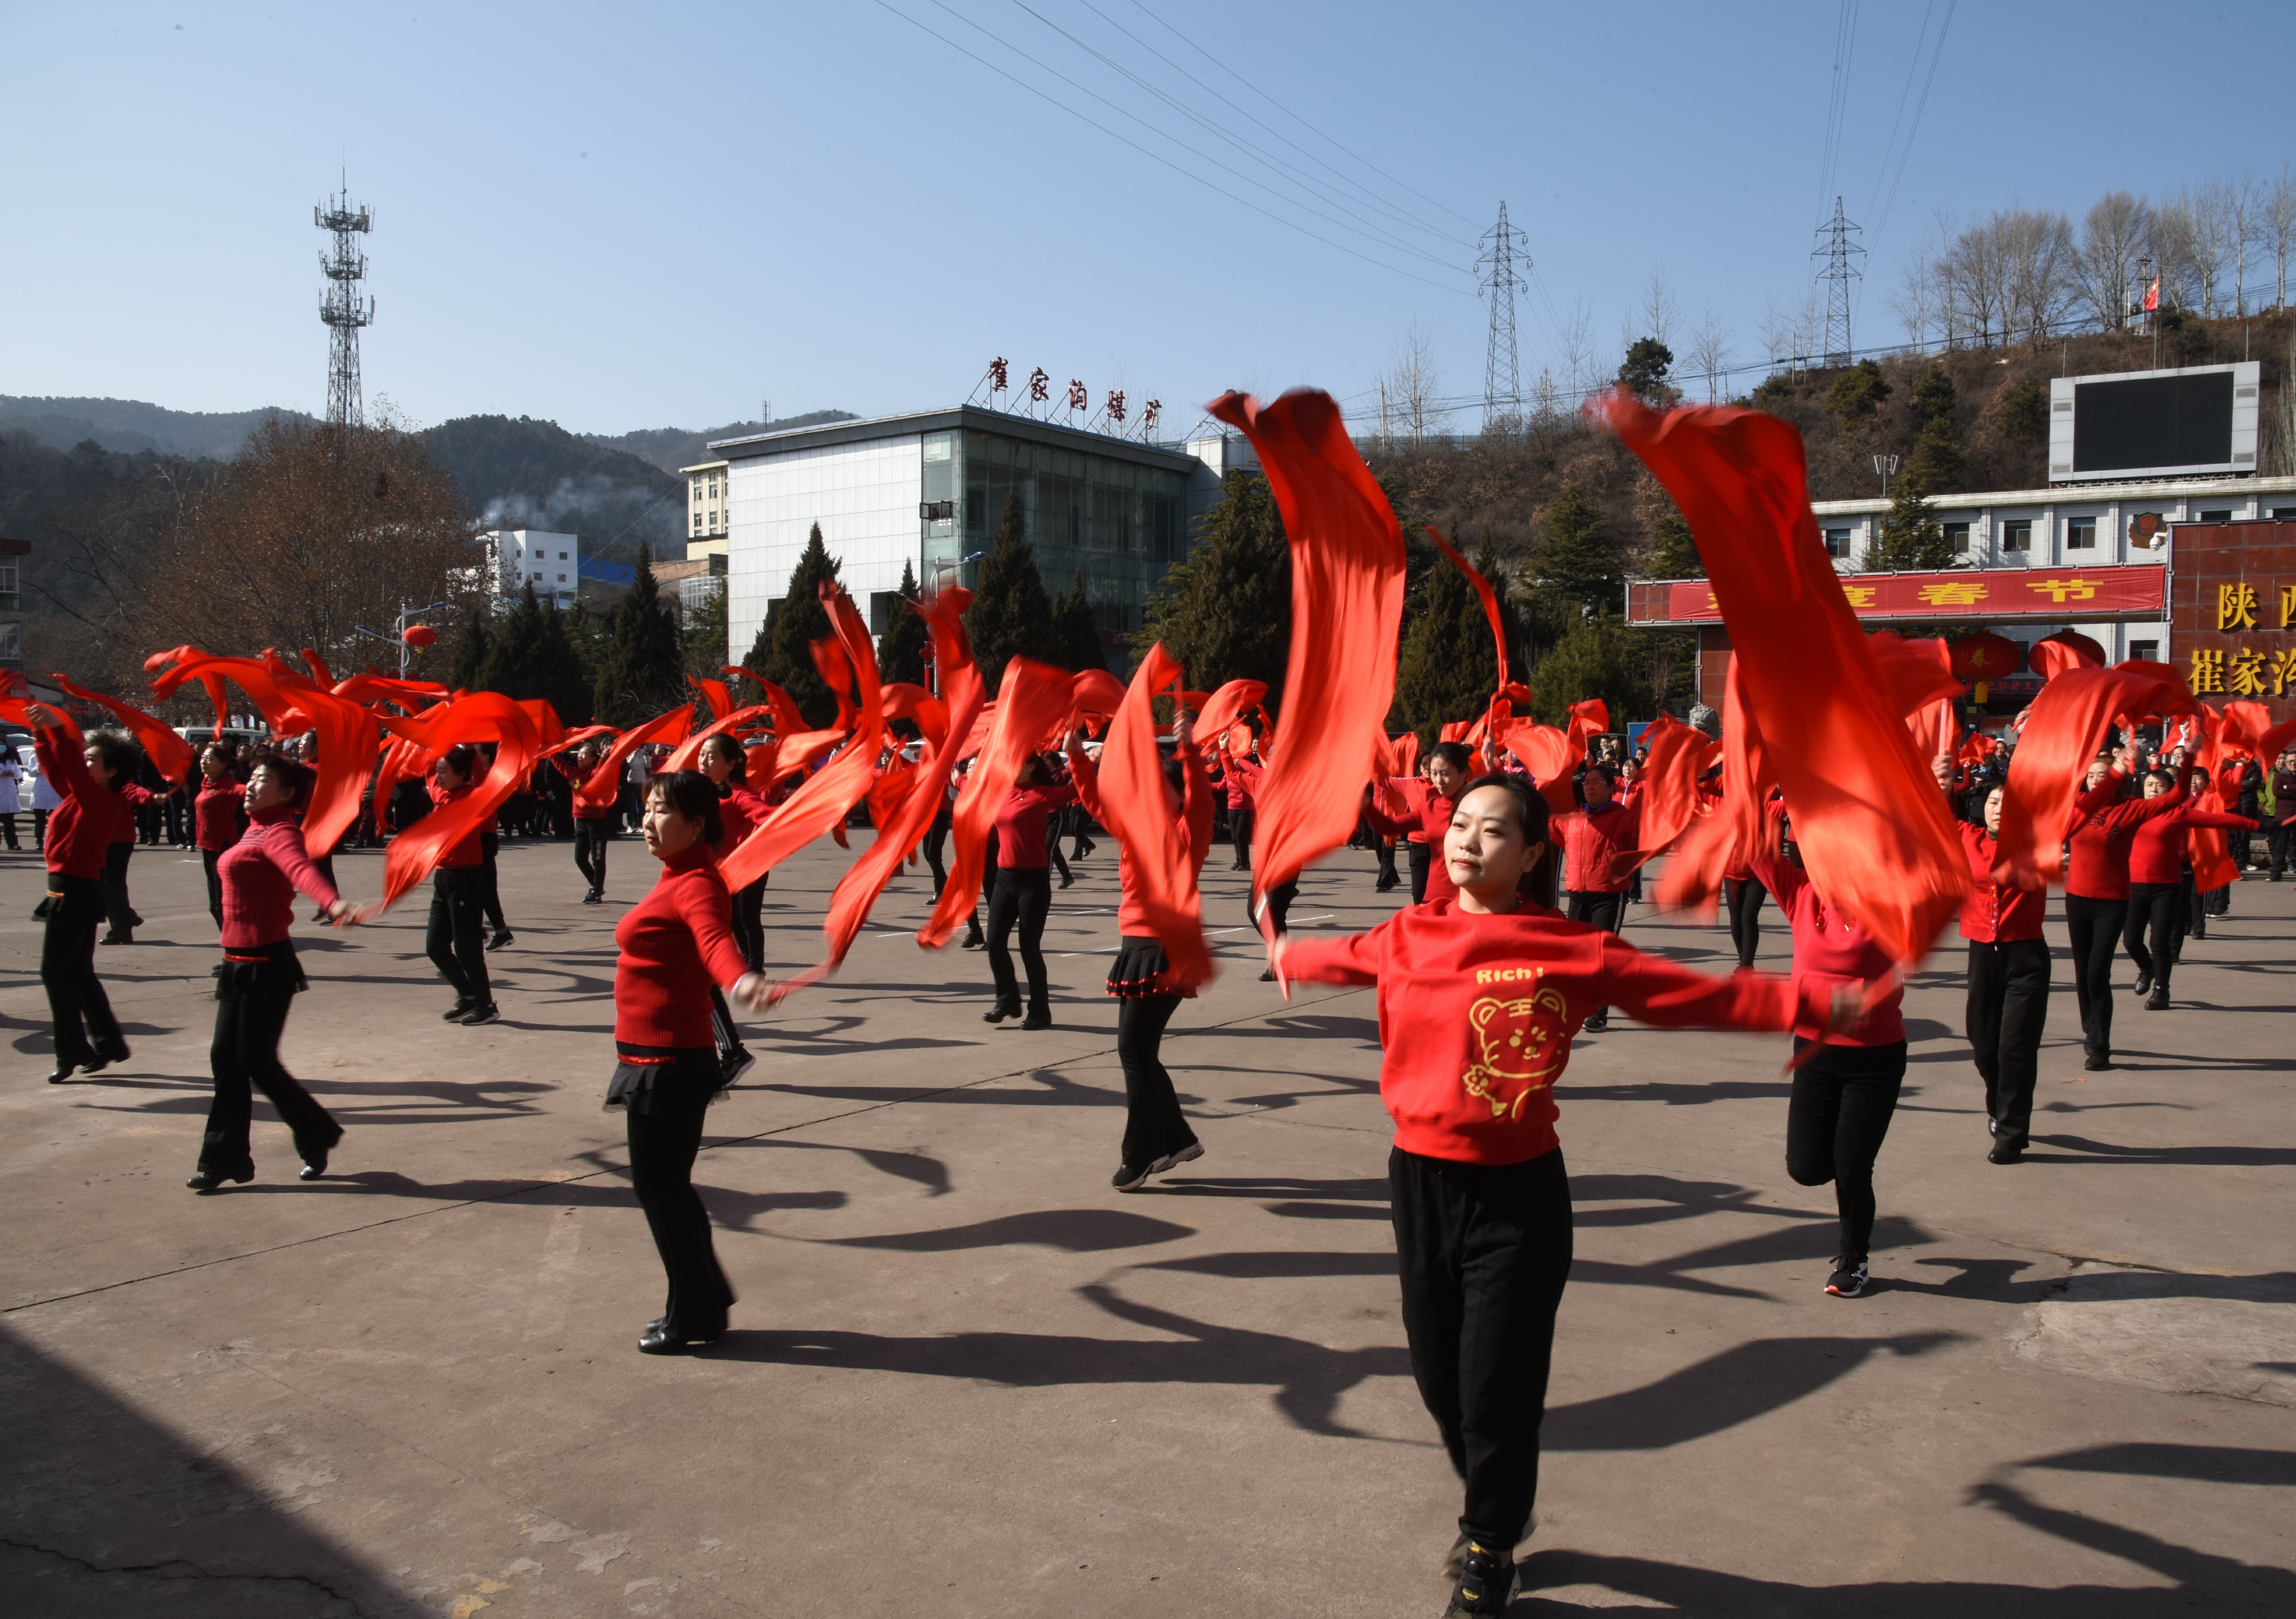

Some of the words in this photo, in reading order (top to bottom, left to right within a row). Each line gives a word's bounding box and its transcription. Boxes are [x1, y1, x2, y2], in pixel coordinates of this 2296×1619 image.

[1706, 579, 2104, 609] 度春节
[1968, 645, 1991, 667] 春
